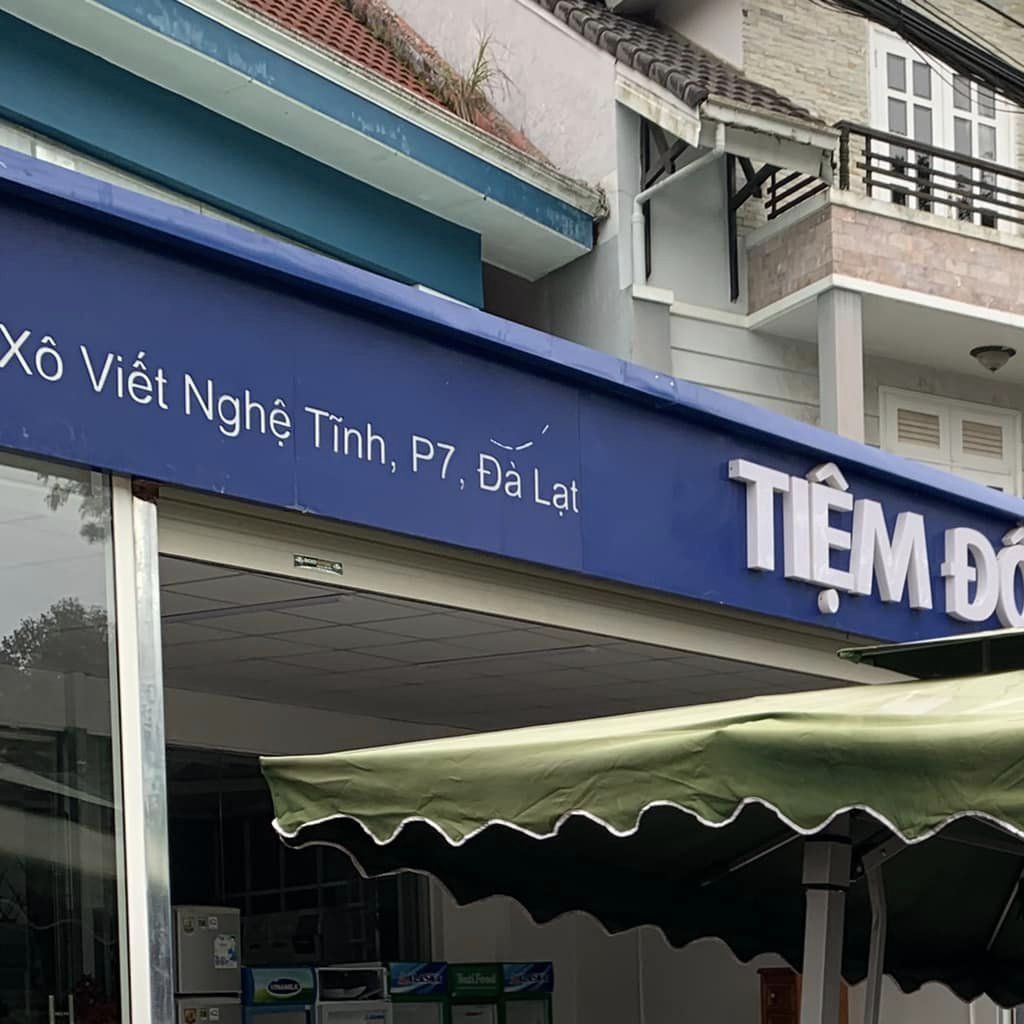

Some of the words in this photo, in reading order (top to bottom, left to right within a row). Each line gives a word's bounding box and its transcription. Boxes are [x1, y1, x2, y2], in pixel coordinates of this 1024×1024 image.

[80, 344, 168, 410] Viết
[185, 375, 292, 447] Nghệ
[477, 453, 522, 498] Đà
[533, 466, 579, 517] Lạt
[728, 458, 933, 614] TIỆM
